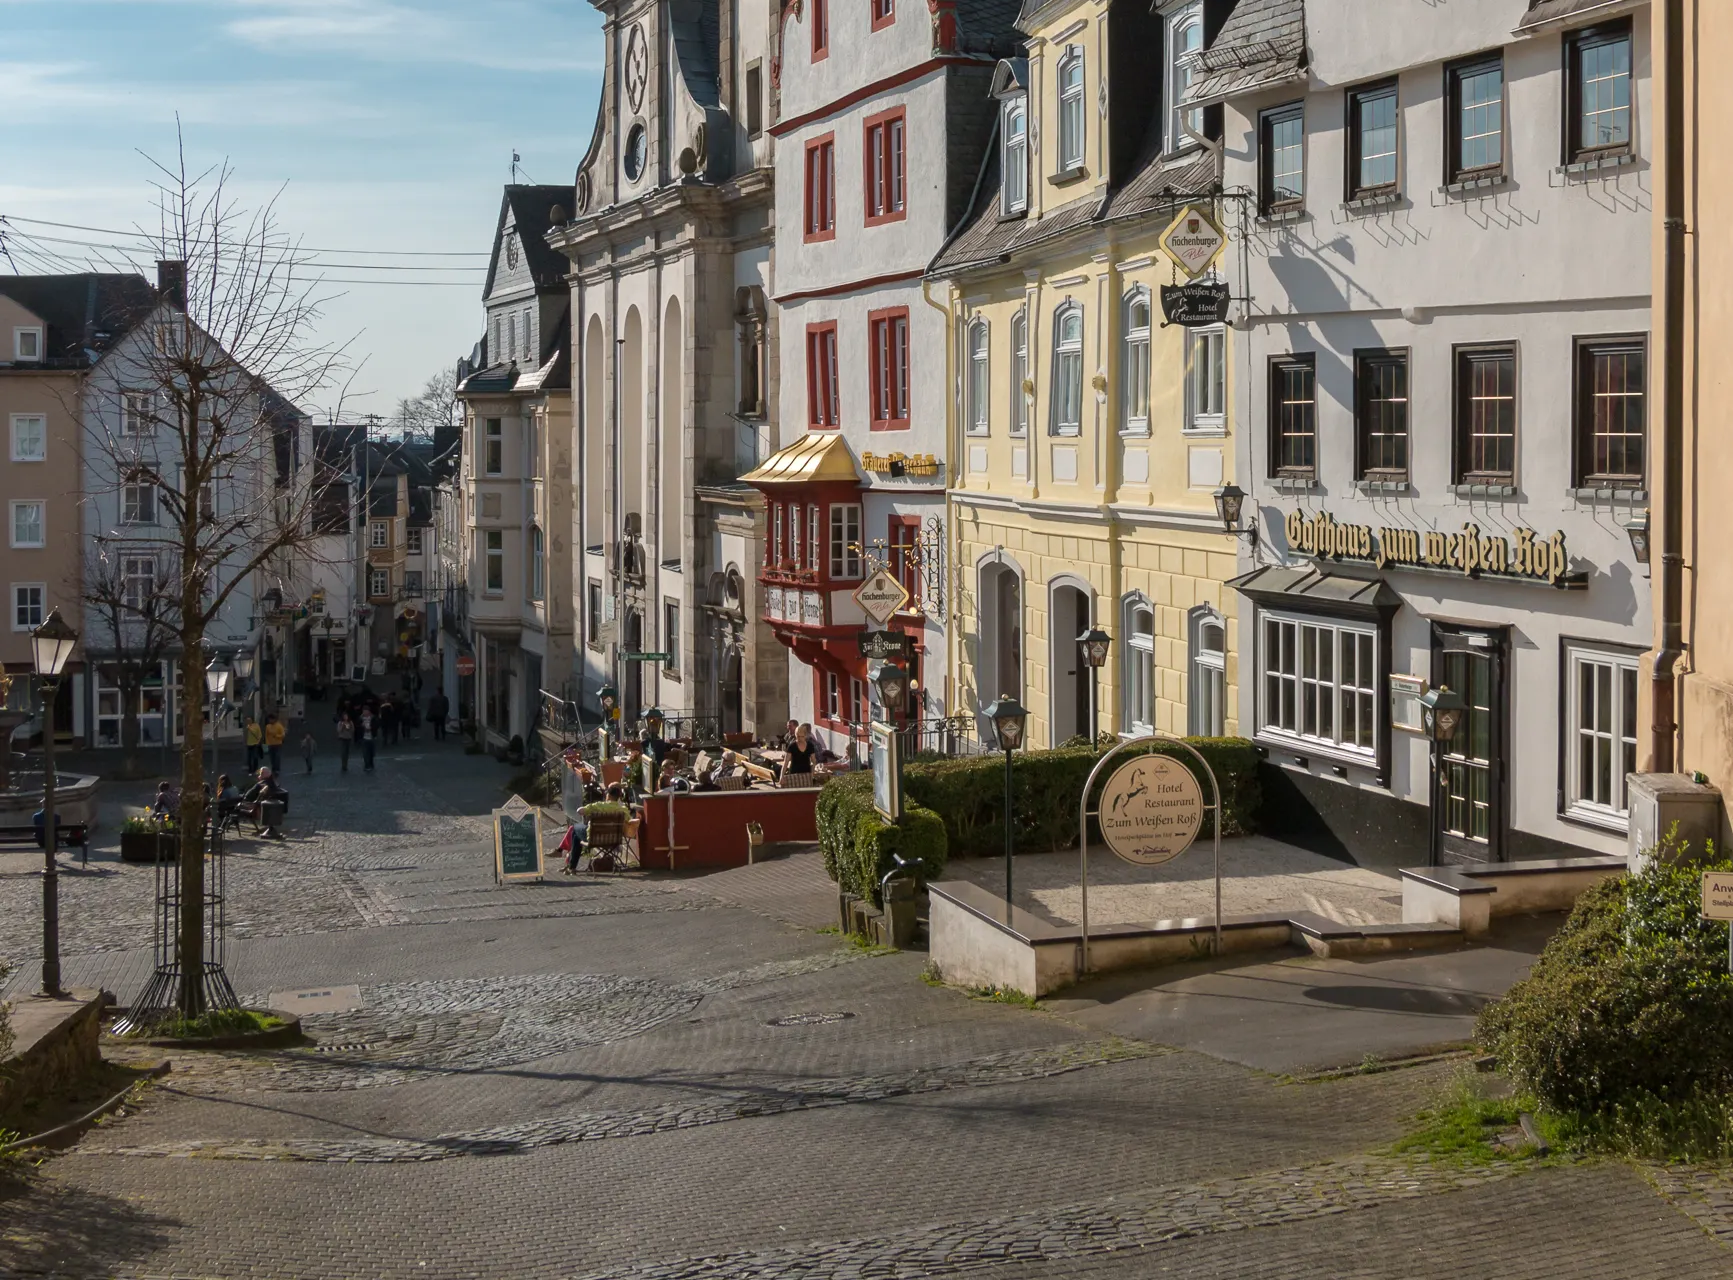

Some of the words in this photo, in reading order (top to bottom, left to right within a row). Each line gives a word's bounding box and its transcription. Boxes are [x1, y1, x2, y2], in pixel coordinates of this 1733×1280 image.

[1171, 235, 1218, 248] Hachenburger
[1165, 292, 1183, 300] Zum
[1184, 287, 1210, 298] Weißen
[1210, 290, 1226, 301] Roß
[1198, 302, 1218, 311] Hotel
[1180, 312, 1218, 321] Restaurant
[1375, 526, 1419, 570] zum
[1424, 521, 1509, 576] weißen
[1512, 526, 1567, 585] Roß
[861, 591, 901, 602] Hachenburger
[1157, 782, 1183, 793] Hotel
[1144, 798, 1195, 809] Restaurant
[1105, 818, 1131, 829] Zum
[1135, 815, 1173, 830] Weißen
[1177, 812, 1197, 828] Roß
